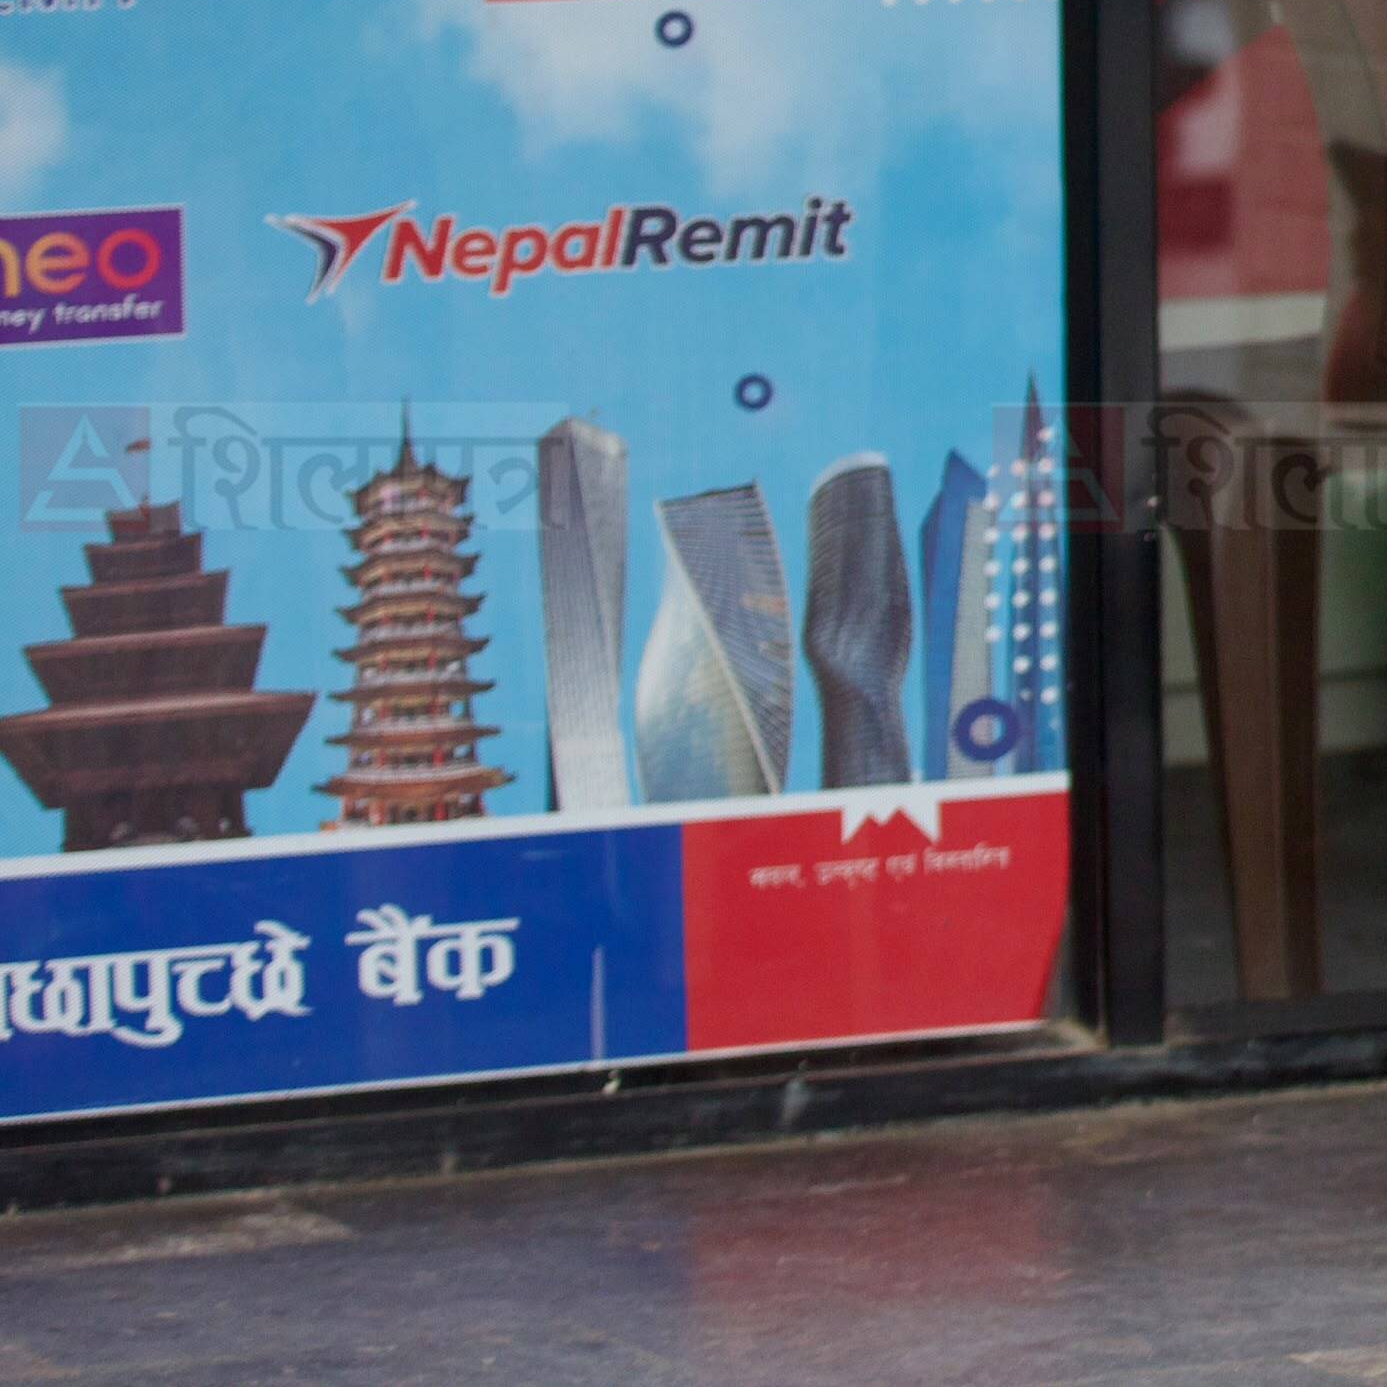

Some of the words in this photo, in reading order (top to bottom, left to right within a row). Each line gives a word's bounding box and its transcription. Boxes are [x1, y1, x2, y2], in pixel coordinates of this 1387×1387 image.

[383, 198, 852, 295] NepalRemit
[54, 293, 165, 325] transfer
[344, 903, 520, 1006] बैंक
